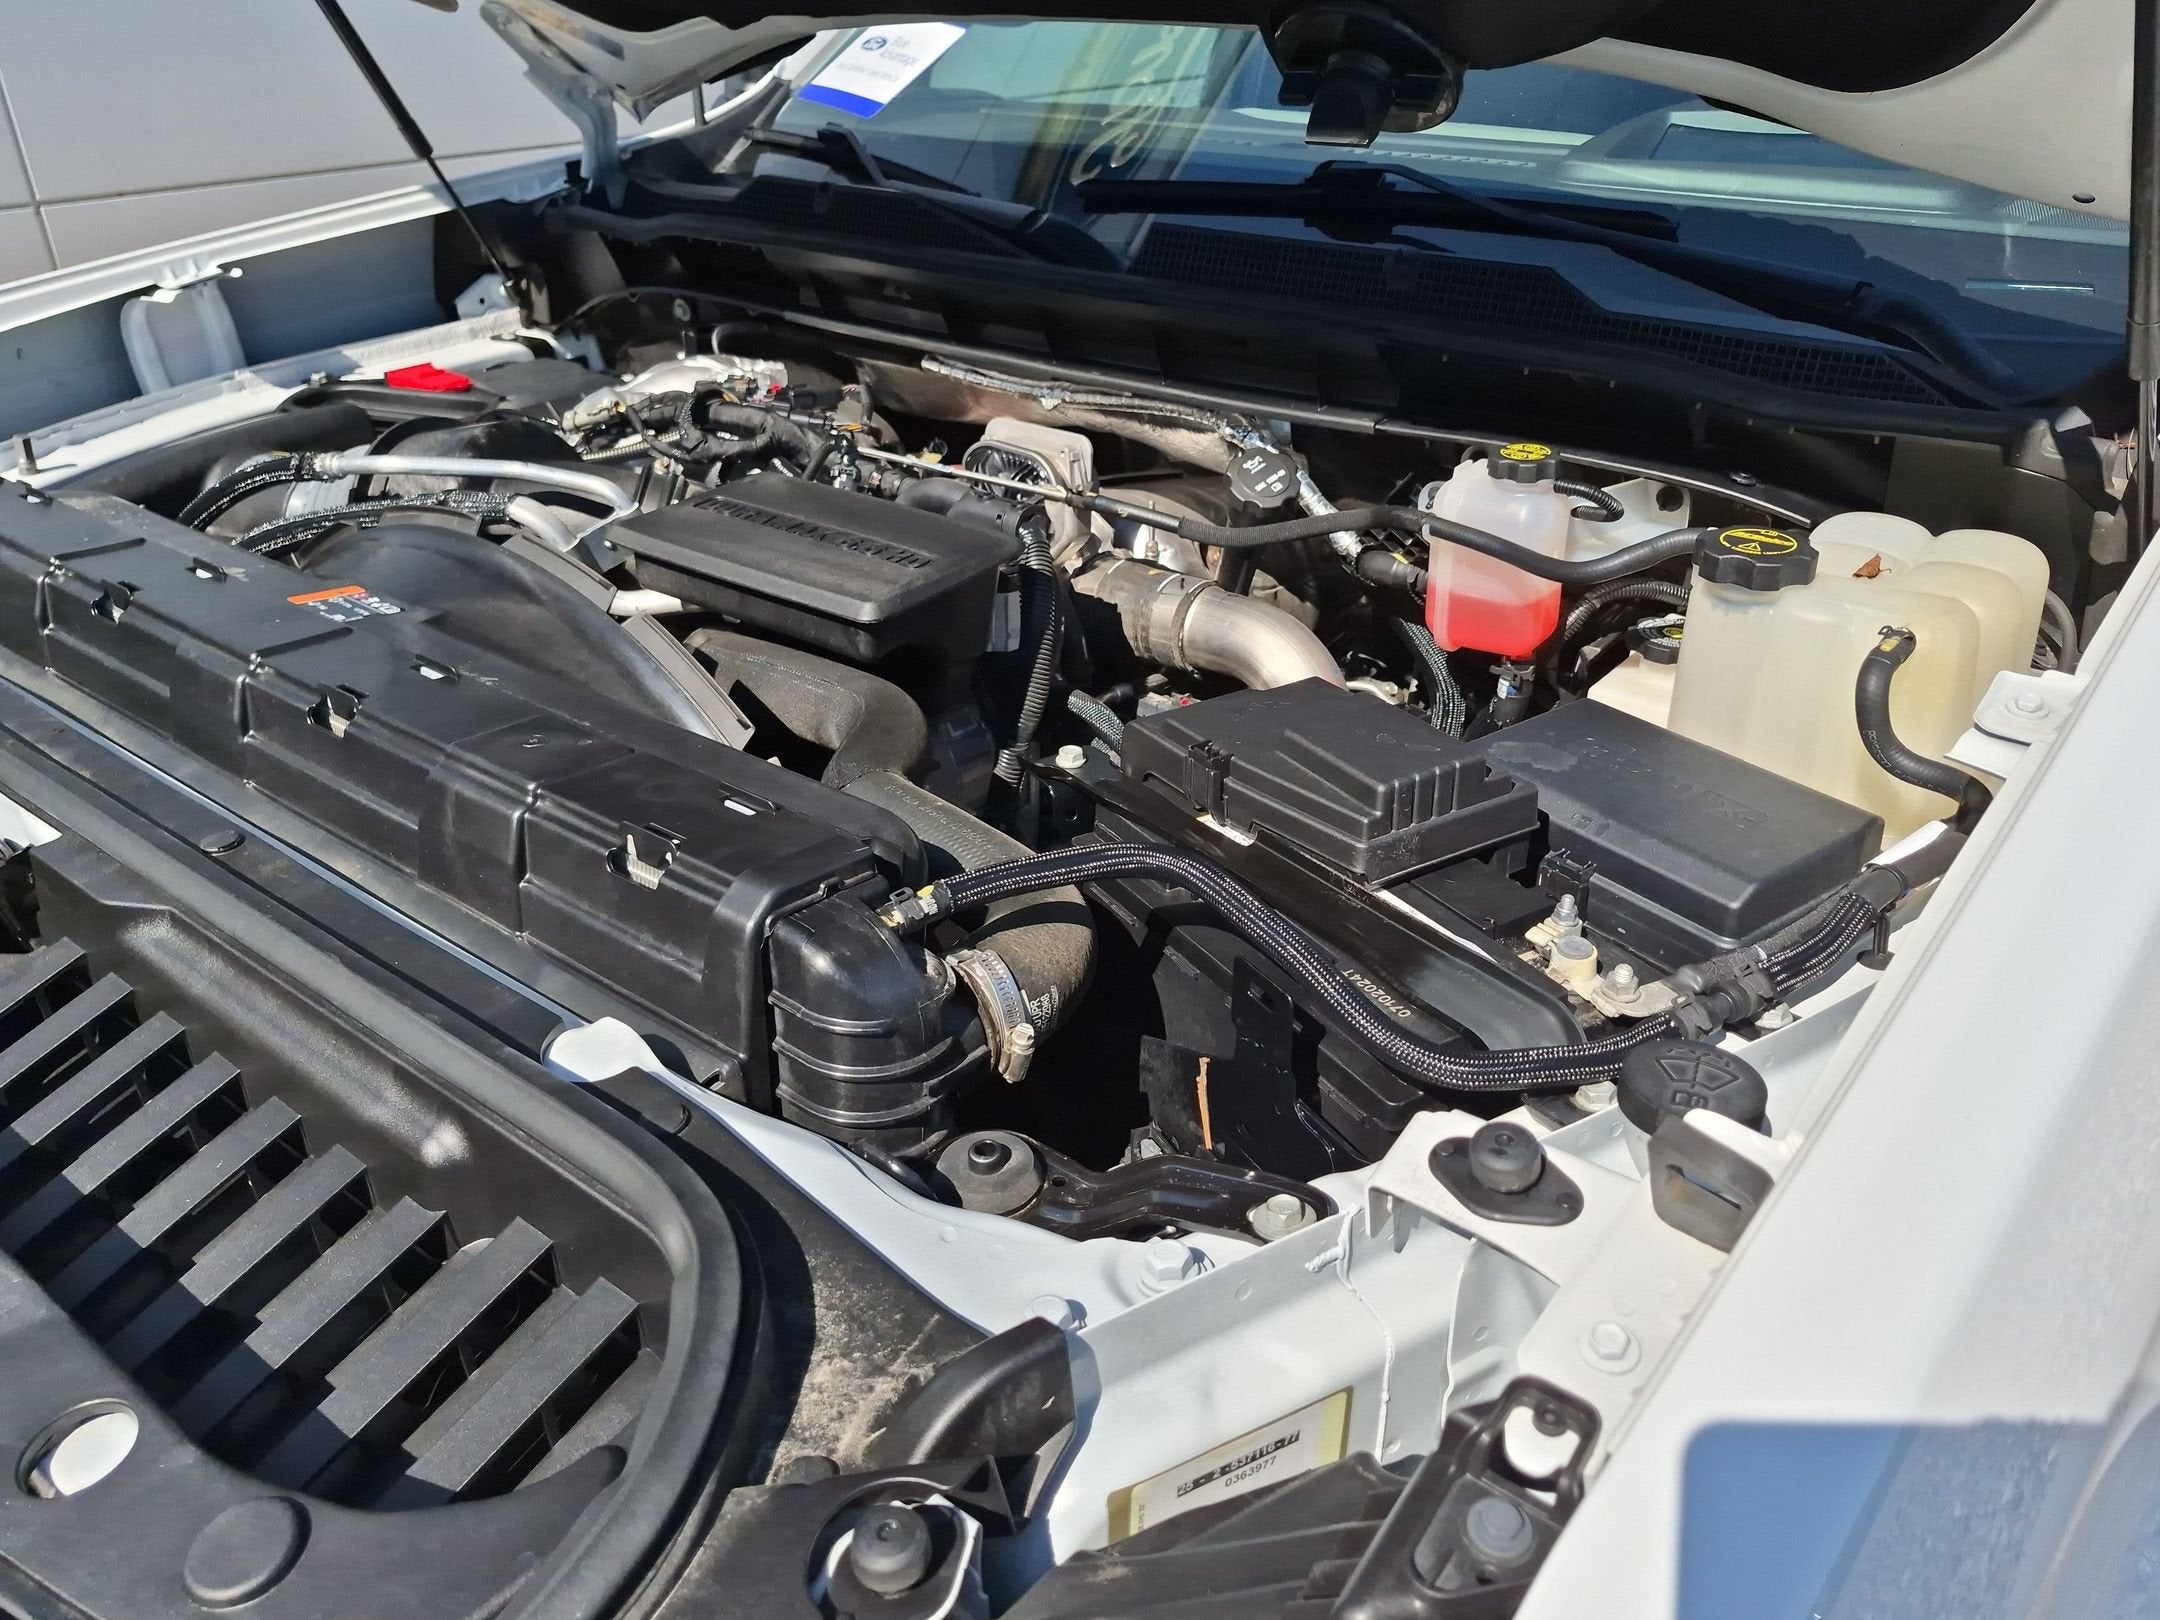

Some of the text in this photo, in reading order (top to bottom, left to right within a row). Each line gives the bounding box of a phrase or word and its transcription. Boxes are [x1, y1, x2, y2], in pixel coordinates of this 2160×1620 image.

[1341, 969, 1411, 1018] 07102024T
[1177, 1480, 1194, 1496] 25
[1225, 1455, 1277, 1488] 0363977
